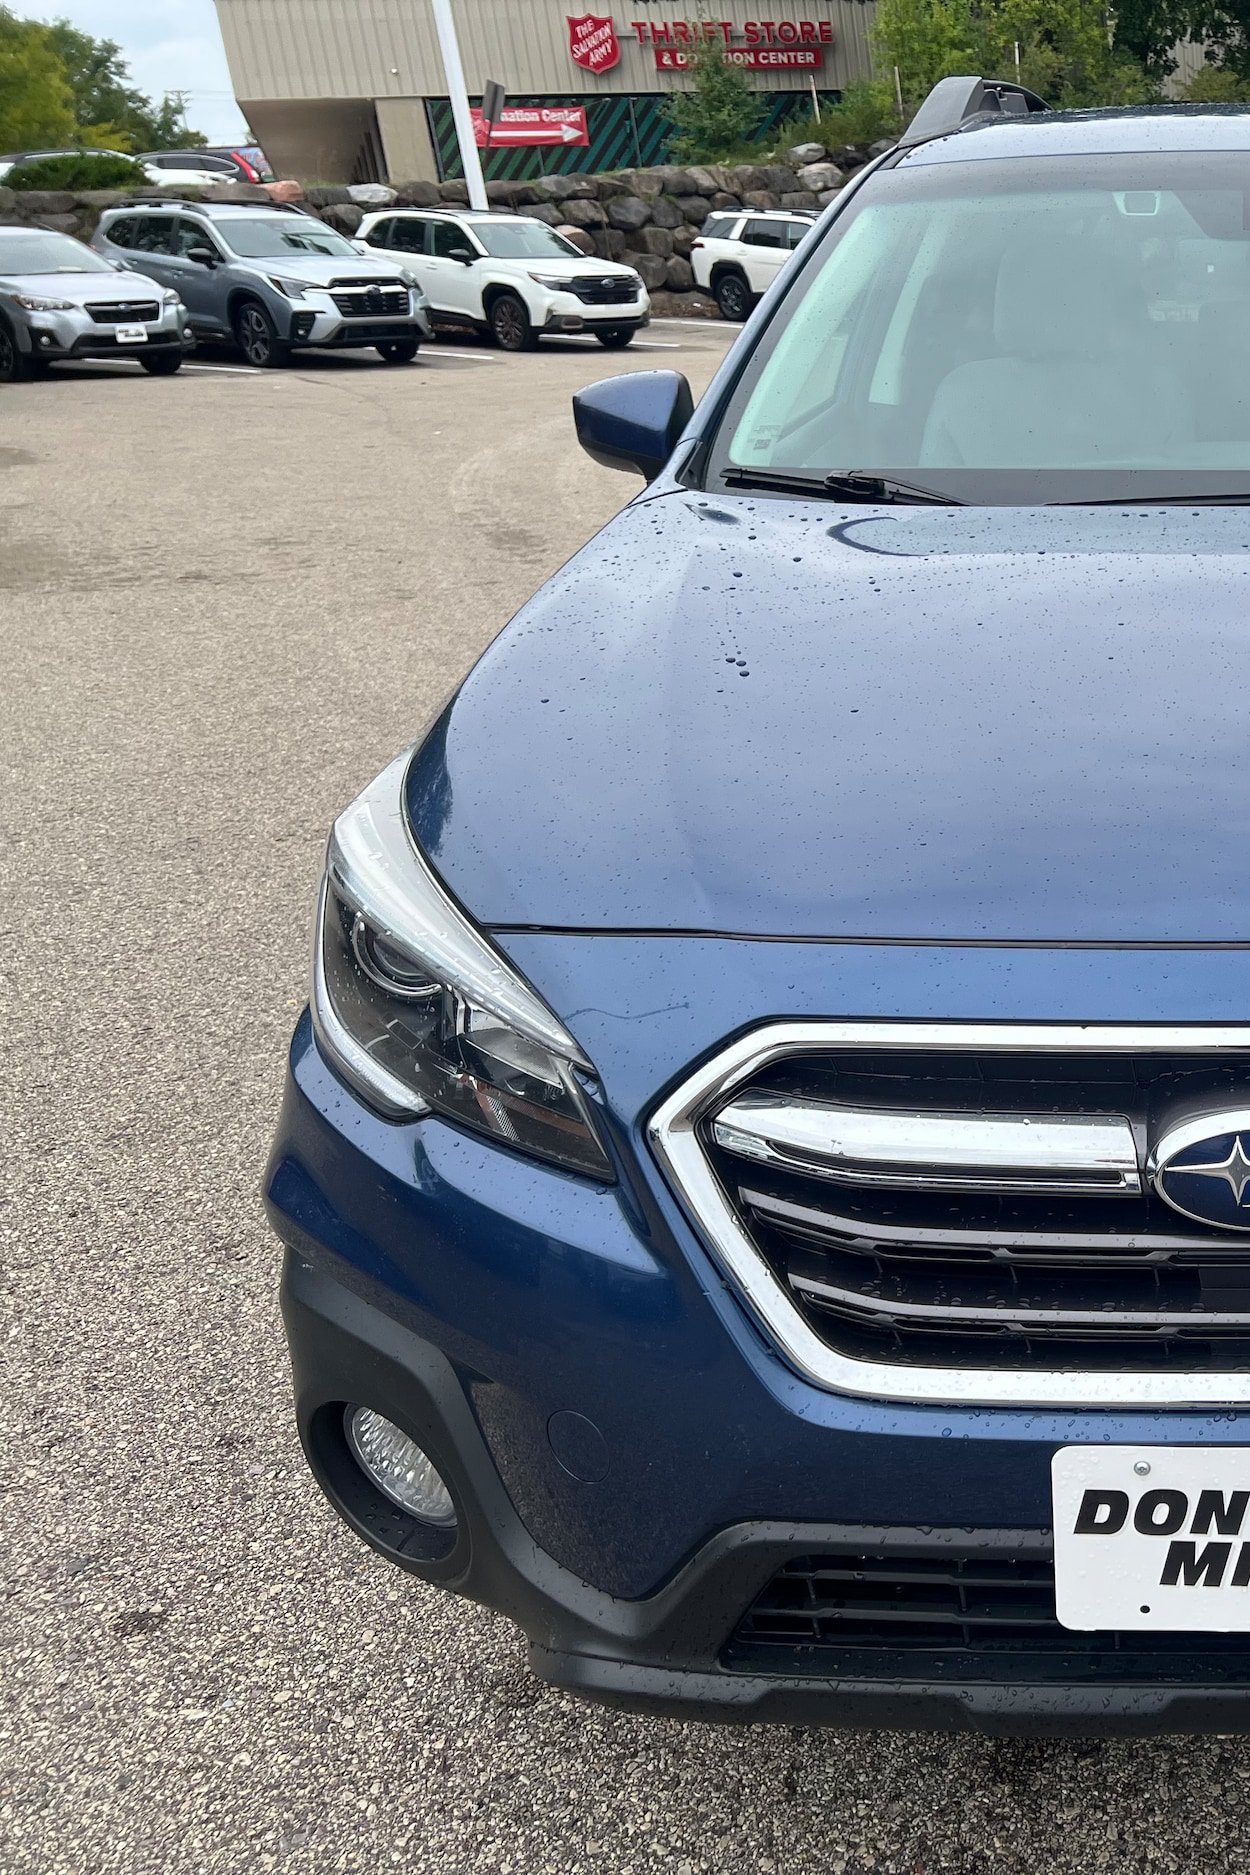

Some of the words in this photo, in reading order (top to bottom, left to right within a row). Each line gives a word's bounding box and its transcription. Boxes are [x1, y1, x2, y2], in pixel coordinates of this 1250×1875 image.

[575, 19, 595, 39] THE
[631, 21, 733, 44] THRIFT
[743, 21, 833, 44] STORE
[588, 38, 612, 66] ARMY
[661, 51, 673, 65] &
[675, 51, 755, 64] DOTION
[758, 52, 815, 64] CENTER
[500, 109, 540, 122] nation
[541, 109, 581, 122] Center
[1073, 1488, 1250, 1535] DON
